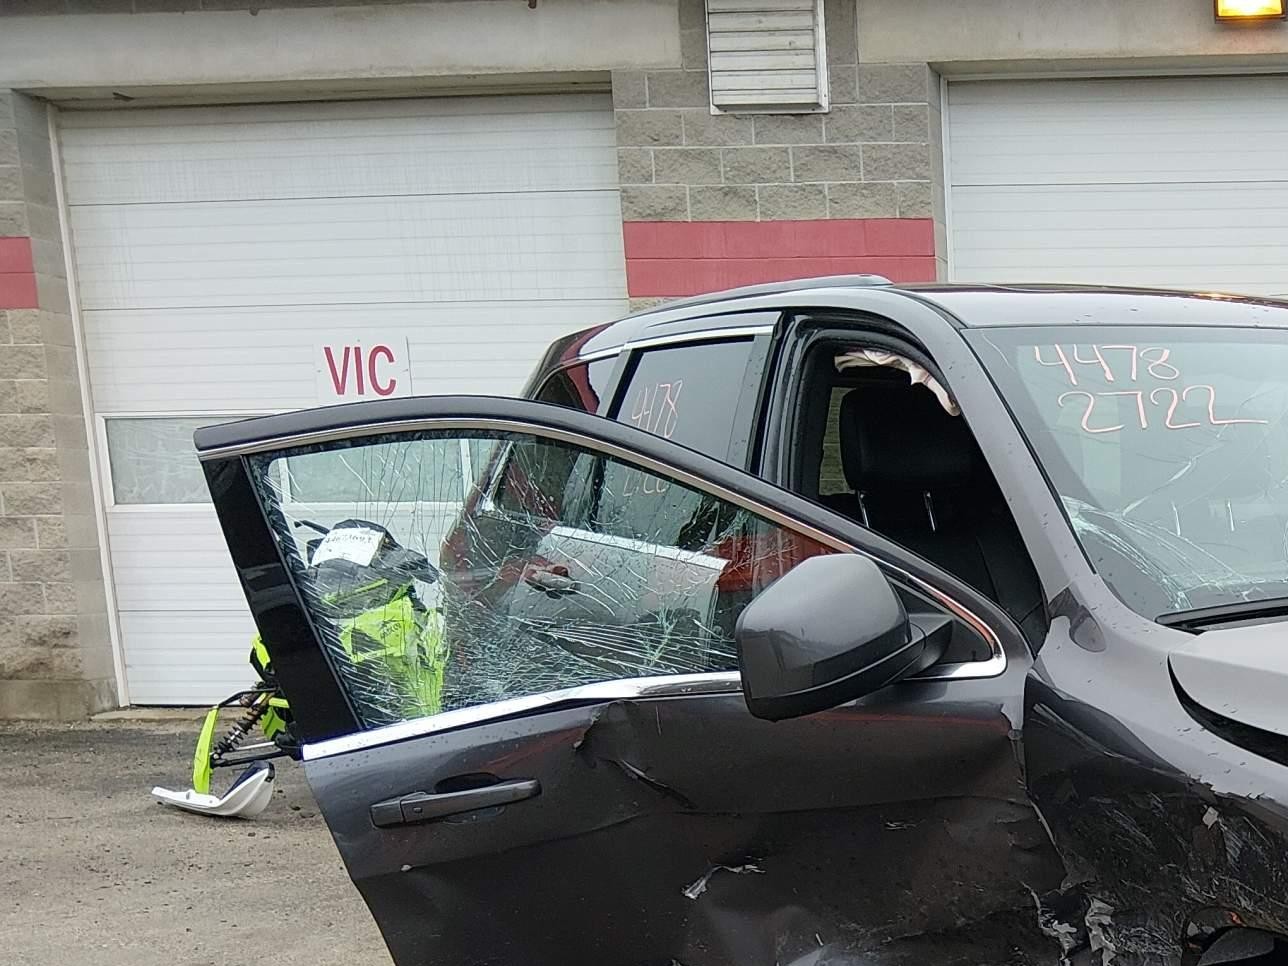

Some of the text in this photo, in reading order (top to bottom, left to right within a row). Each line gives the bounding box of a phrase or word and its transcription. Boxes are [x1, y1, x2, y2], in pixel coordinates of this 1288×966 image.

[323, 345, 397, 396] VIC
[1034, 343, 1181, 387] 4478
[1057, 384, 1269, 434] 2722
